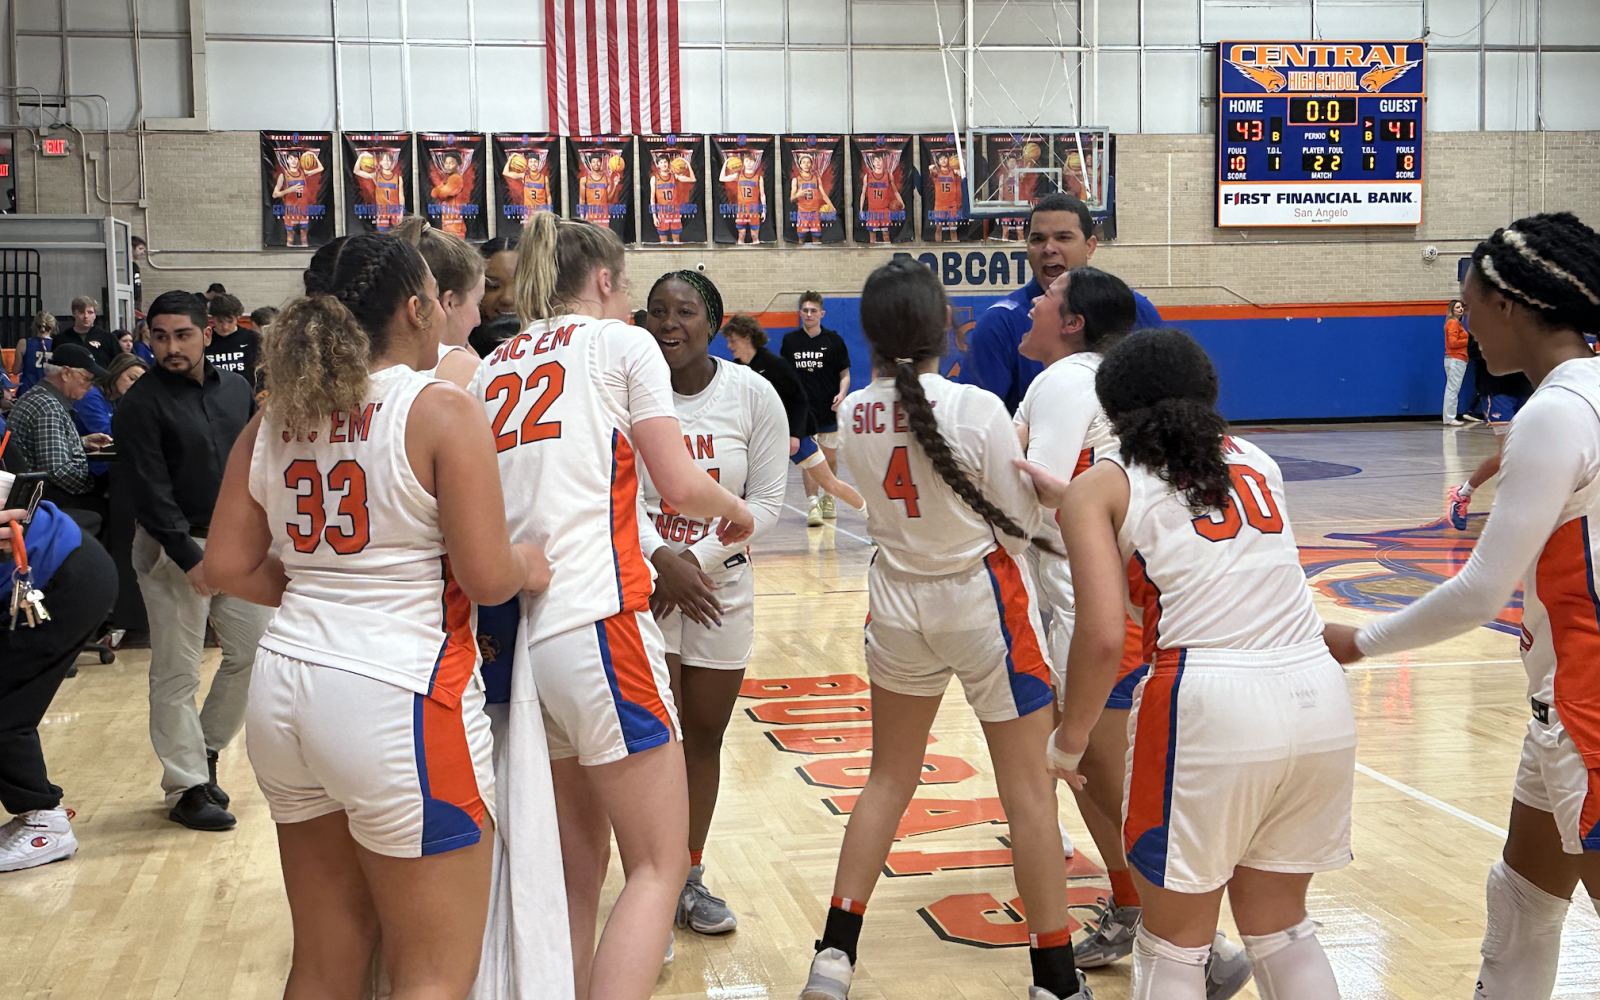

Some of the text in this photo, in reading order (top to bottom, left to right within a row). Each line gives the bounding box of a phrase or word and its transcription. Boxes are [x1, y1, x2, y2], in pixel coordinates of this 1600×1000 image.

[1230, 45, 1409, 68] CENTRAL
[1287, 71, 1360, 91] HIGH SCHOOL
[1229, 99, 1264, 113] HOME
[1379, 99, 1418, 113] GUEST
[1235, 120, 1263, 141] 43
[1329, 129, 1340, 142] 4
[1388, 121, 1415, 139] 41
[1272, 131, 1280, 141] B
[1304, 132, 1326, 140] PERIOD
[1364, 131, 1373, 141] B
[46, 139, 66, 154] EXIT
[1227, 147, 1247, 155] FOULS
[1395, 146, 1415, 154] FOULS
[1230, 155, 1246, 171] 10
[1403, 155, 1414, 171] 8
[1227, 172, 1247, 180] SCORE
[1311, 172, 1333, 180] MATCH
[1395, 171, 1415, 179] SCORE
[743, 187, 753, 198] 12
[941, 183, 951, 193] 15
[531, 190, 538, 200] 3
[594, 190, 602, 200] 5
[662, 190, 673, 201] 10
[873, 190, 884, 200] 14
[1224, 192, 1413, 206] FIRST FINANCIAL BANK
[272, 205, 303, 216] CENTRAL
[354, 205, 383, 215] CENTRAL
[427, 204, 457, 214] CENTRAL
[503, 204, 532, 215] CENTRAL
[576, 204, 606, 215] CENTRAL
[1294, 207, 1348, 220] San Angelo
[489, 333, 533, 366] SIC
[206, 352, 244, 363] SHIP
[793, 351, 824, 360] SHIP
[795, 360, 824, 368] HOOPS
[485, 360, 566, 453] 22
[853, 402, 885, 434] SIC
[883, 446, 921, 518] 4
[284, 458, 371, 555] 33
